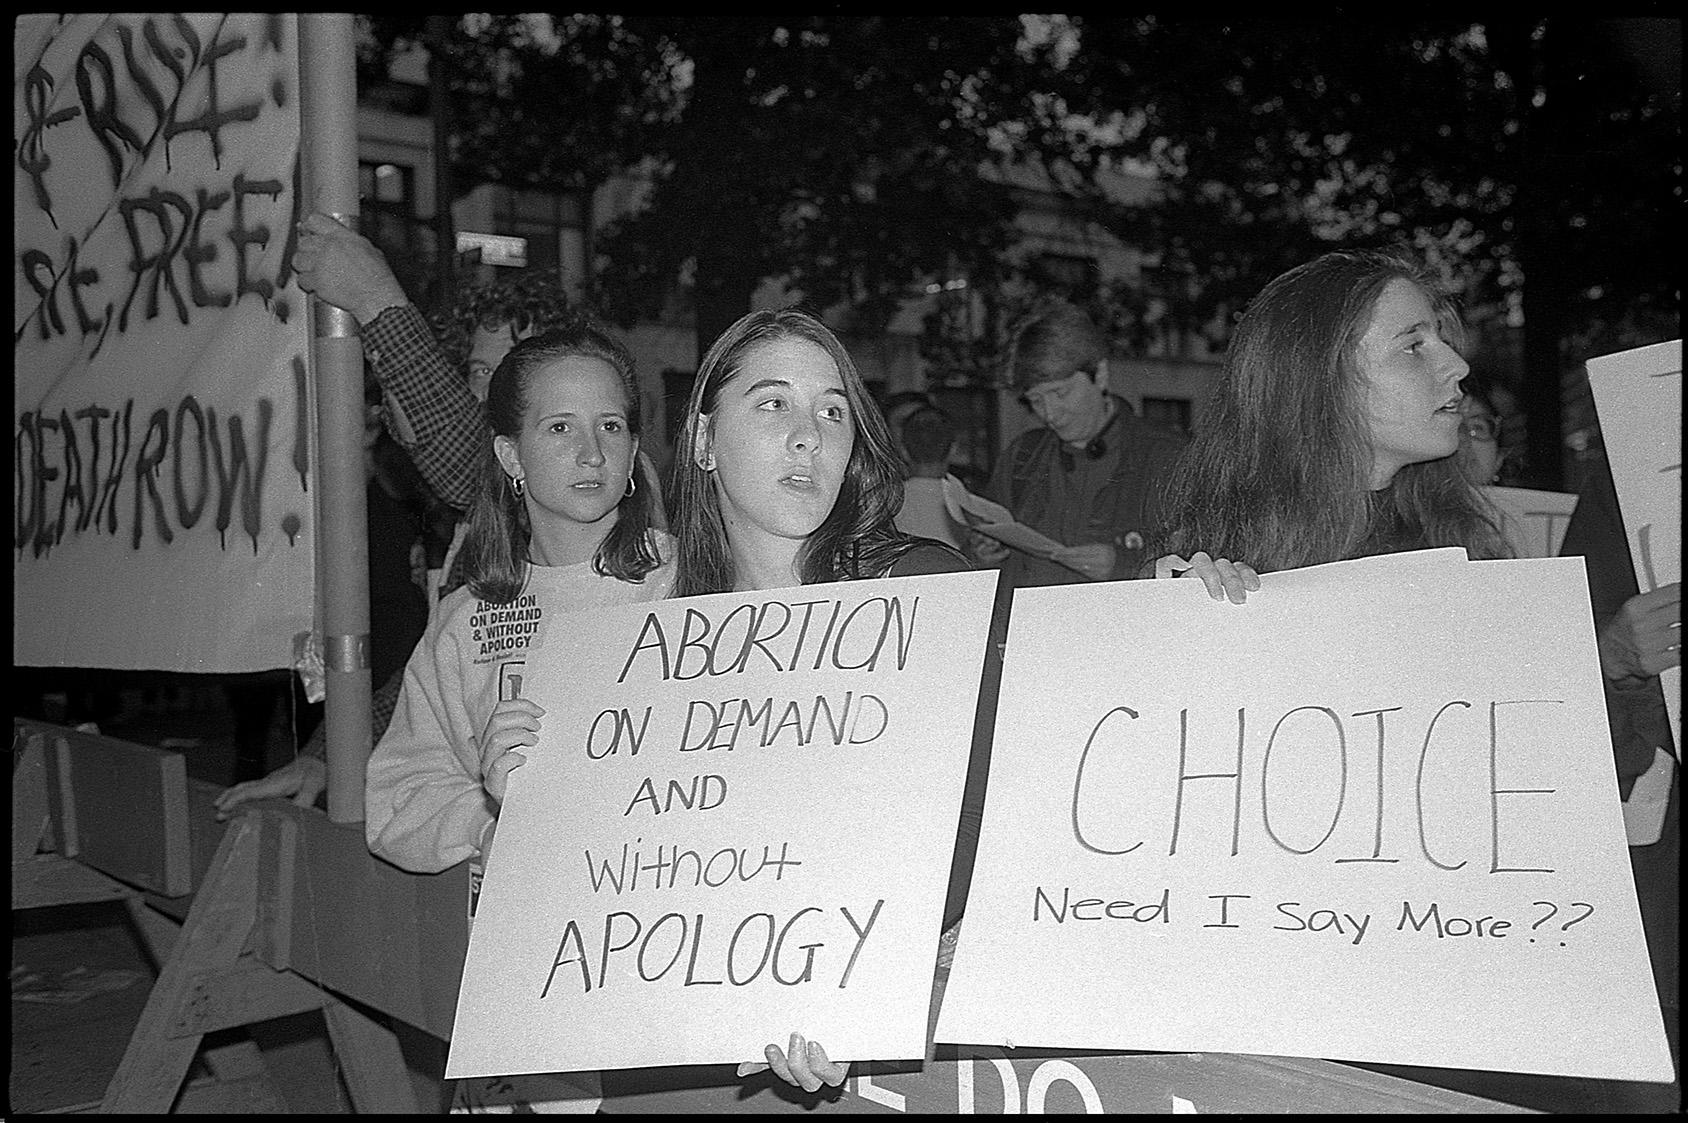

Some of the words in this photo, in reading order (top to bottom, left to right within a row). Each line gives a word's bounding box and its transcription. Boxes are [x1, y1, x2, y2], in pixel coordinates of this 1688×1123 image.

[470, 615, 487, 628] ON
[490, 608, 542, 624] DEMAND
[472, 629, 482, 641] &
[486, 622, 540, 639] WITHOUT
[480, 636, 532, 655] APOLOGY
[617, 596, 919, 684] ABORTION
[586, 705, 653, 760] ON
[679, 690, 889, 753] DEMAND
[623, 774, 728, 817] AND
[1071, 700, 1566, 875] CHOICE
[1032, 885, 1170, 925] Need
[1202, 894, 1252, 929] I
[1273, 901, 1371, 946] Say
[539, 898, 886, 1000] APOLOGY
